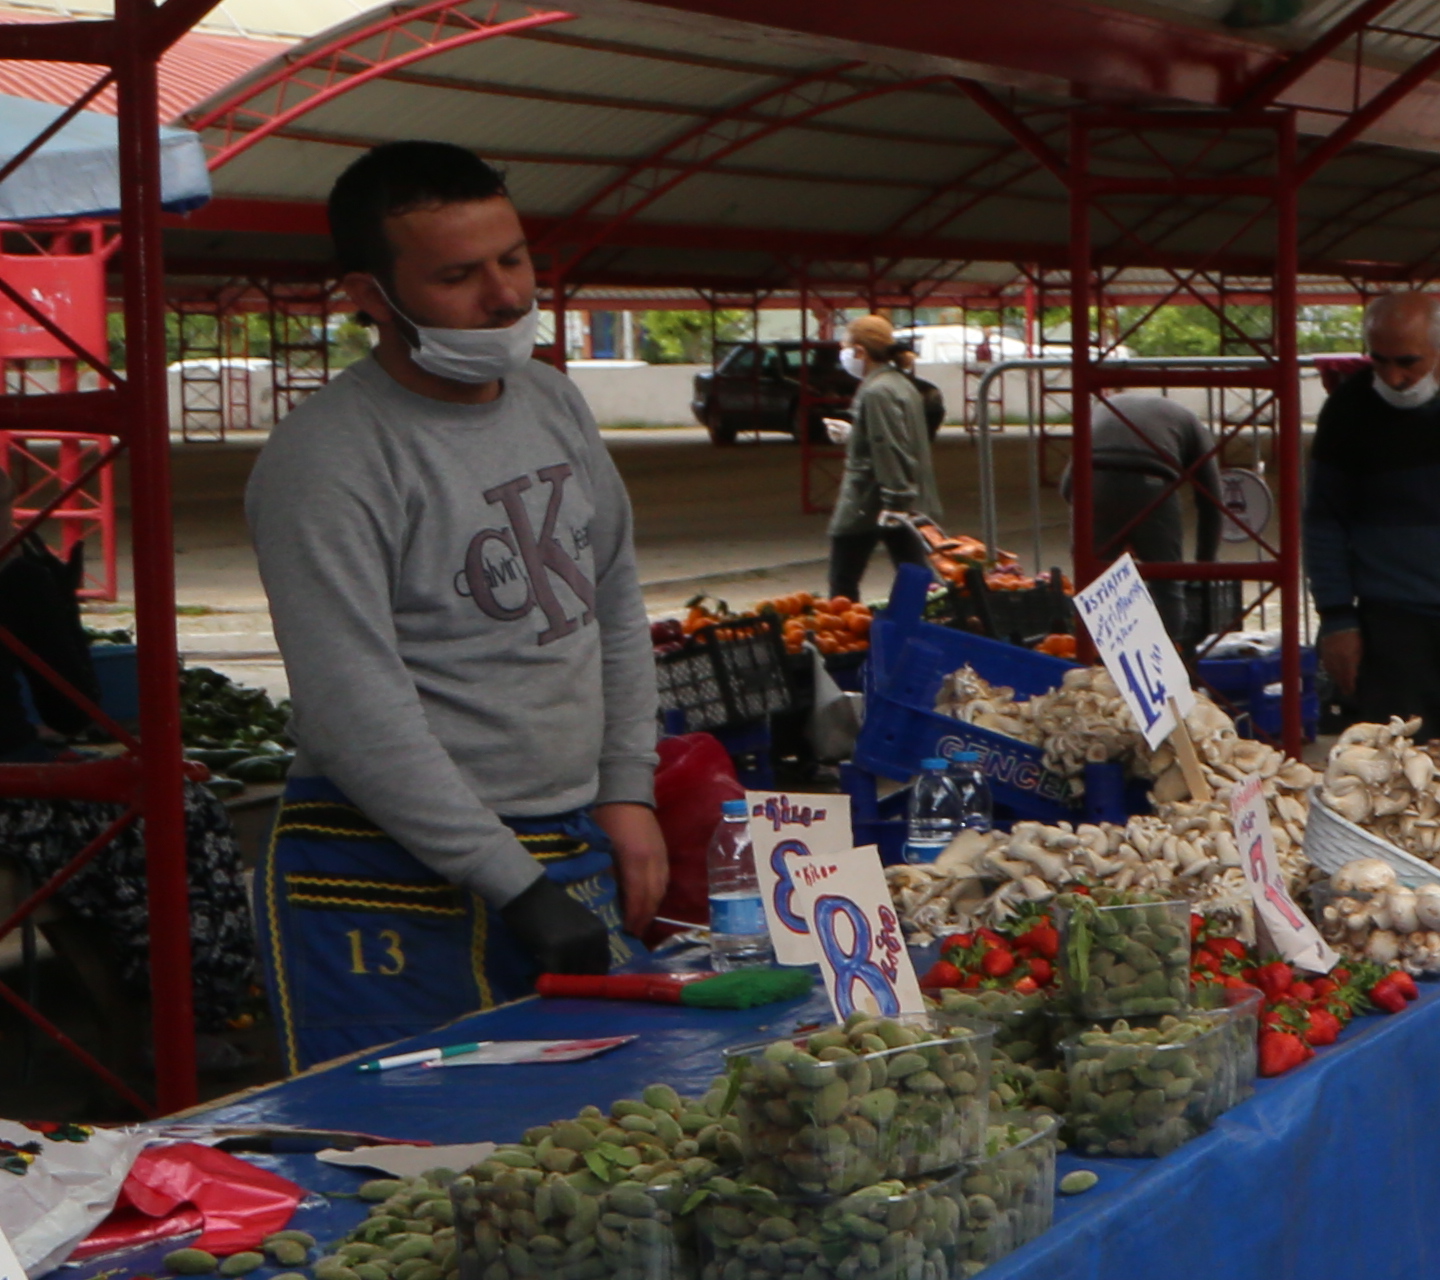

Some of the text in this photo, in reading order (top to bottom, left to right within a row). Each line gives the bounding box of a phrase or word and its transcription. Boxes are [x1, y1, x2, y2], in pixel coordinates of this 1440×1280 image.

[1117, 649, 1167, 735] 14
[344, 929, 405, 976] 13
[814, 893, 900, 1021] 8
